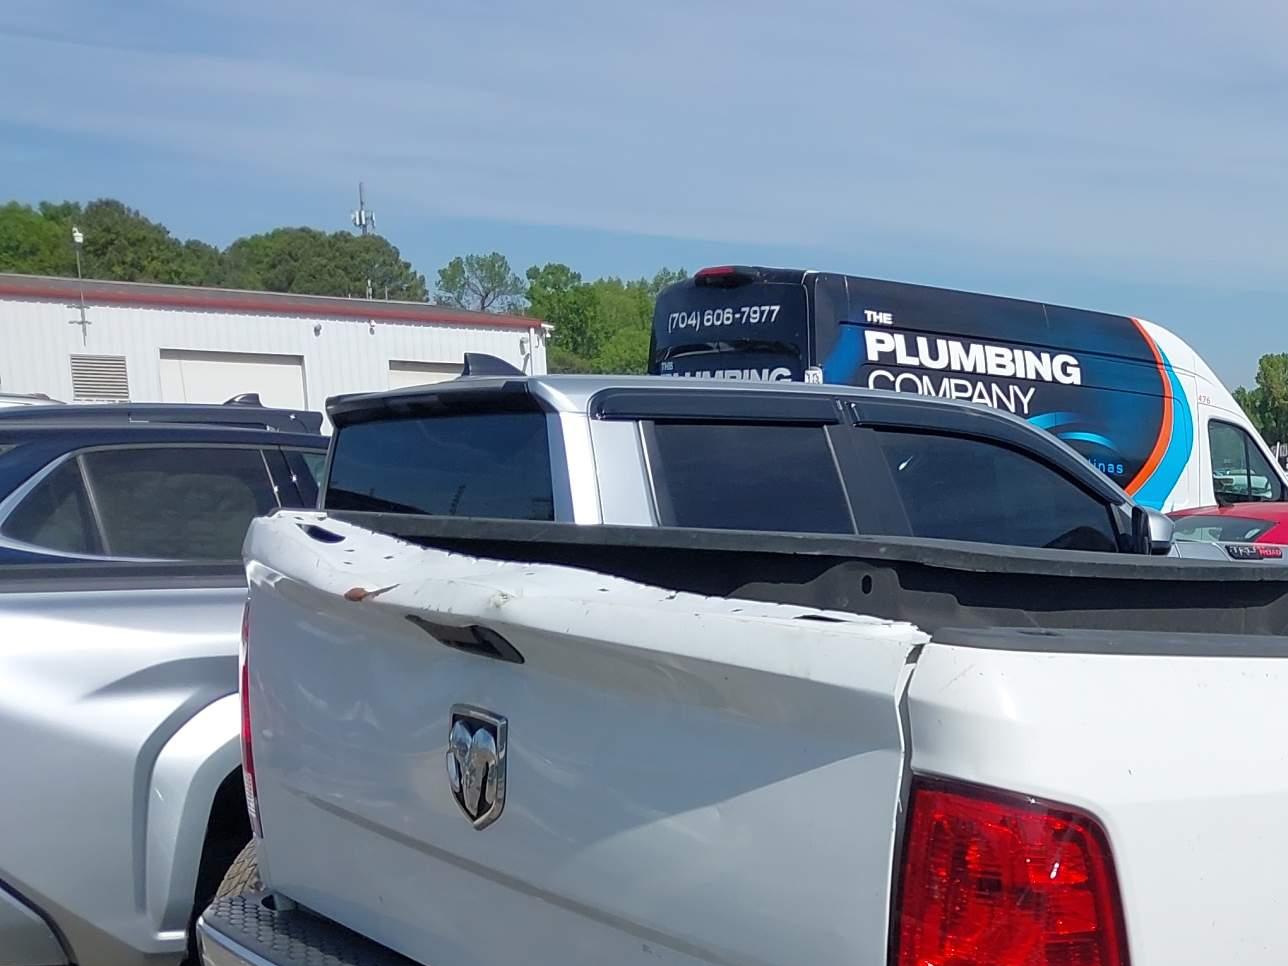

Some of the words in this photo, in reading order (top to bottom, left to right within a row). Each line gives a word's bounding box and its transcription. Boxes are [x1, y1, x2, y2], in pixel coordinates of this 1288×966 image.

[668, 312, 701, 333] (704)
[703, 306, 781, 327] 606-7977
[864, 309, 894, 325] THE
[864, 330, 1082, 386] PLUMBING
[868, 369, 1036, 415] COMPANY
